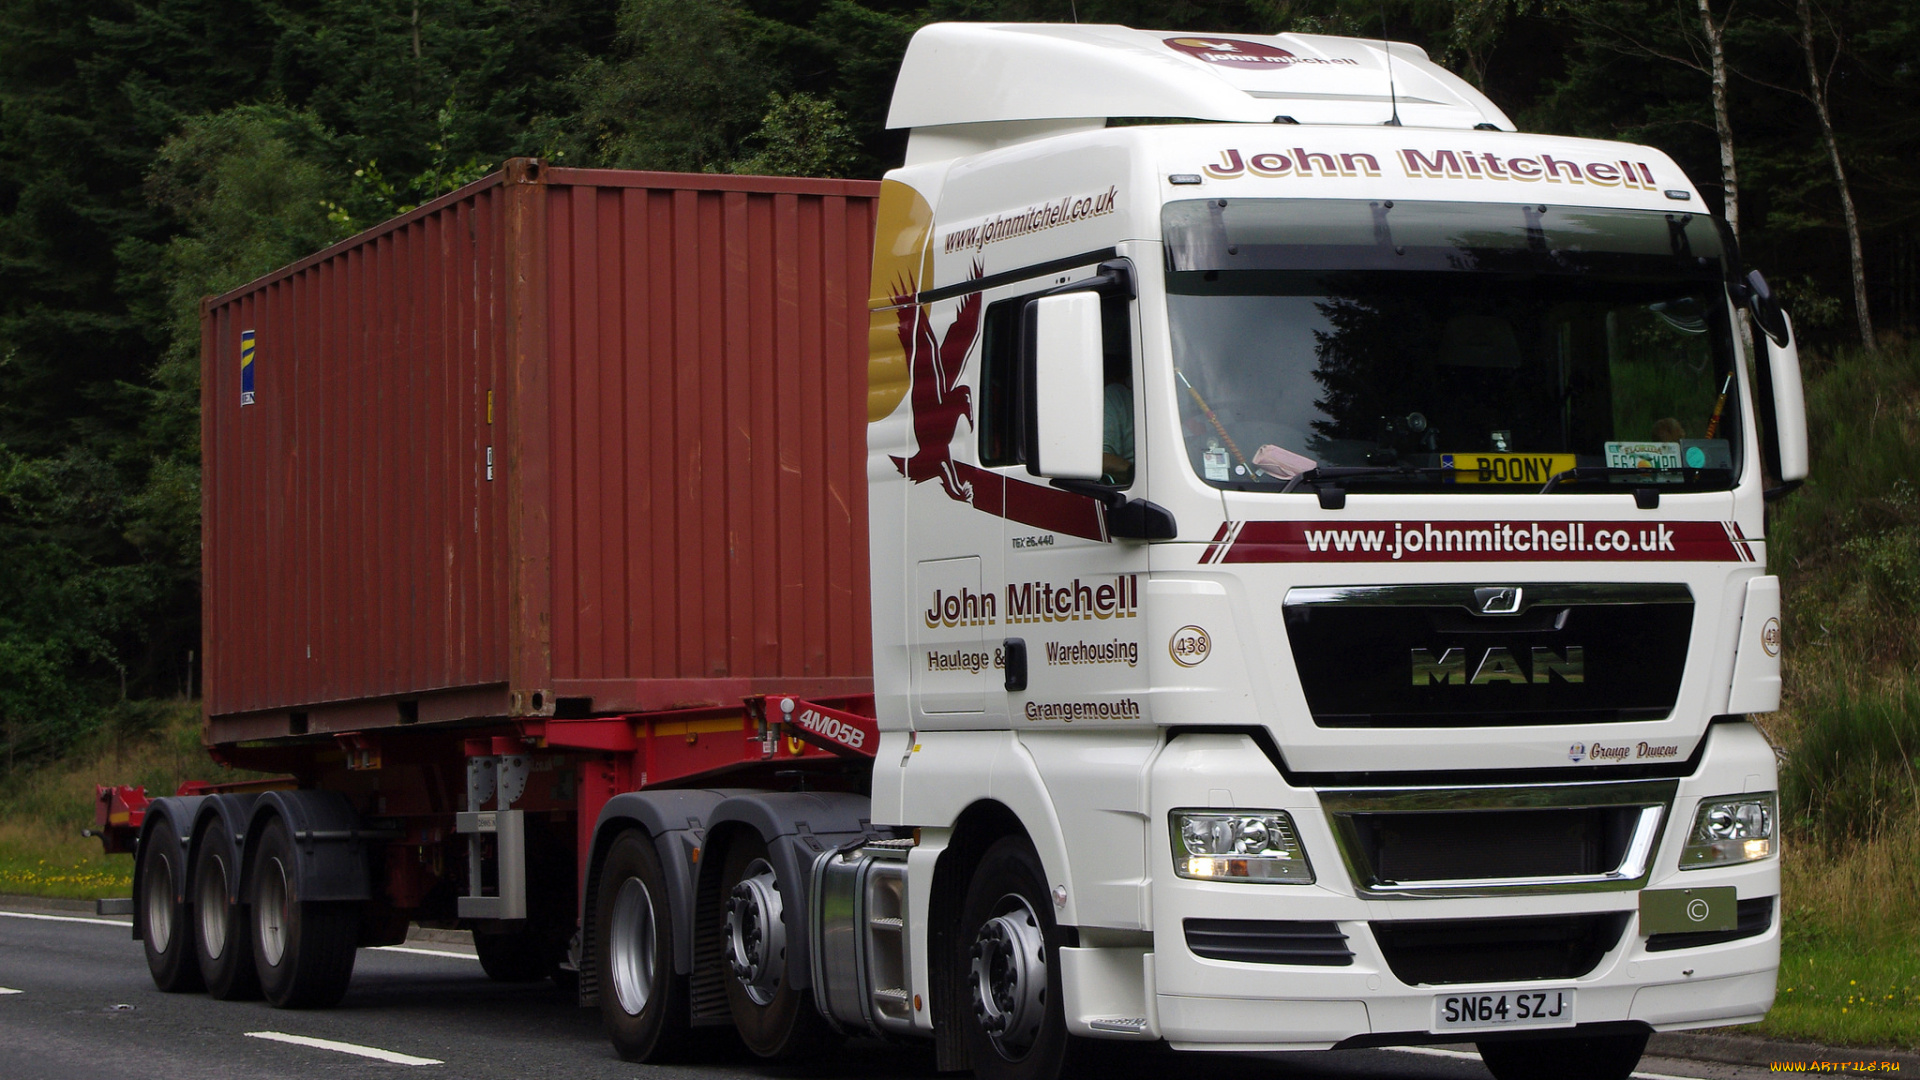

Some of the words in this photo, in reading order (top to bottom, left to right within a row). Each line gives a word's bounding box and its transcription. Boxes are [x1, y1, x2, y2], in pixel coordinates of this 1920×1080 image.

[1202, 147, 1382, 179] John
[1396, 148, 1657, 191] Mitchell
[944, 185, 1119, 254] www.johnmitchell.co.uk
[1476, 457, 1553, 482] BOONY
[1304, 522, 1676, 560] www.johnmitchell.co.uk
[925, 587, 997, 629] John
[1005, 575, 1138, 625] Mitchell
[928, 649, 990, 675] Haulage
[993, 648, 1006, 671] &
[1045, 639, 1139, 669] Warehousing
[1174, 636, 1208, 656] 438
[1411, 645, 1585, 687] MAN
[799, 708, 866, 749] 4M05B
[1025, 698, 1141, 723] Grangemouth
[1589, 741, 1631, 763] Grange
[1635, 741, 1679, 759] Duncan
[1444, 994, 1510, 1023] SN64
[1516, 991, 1564, 1019] SZJ
